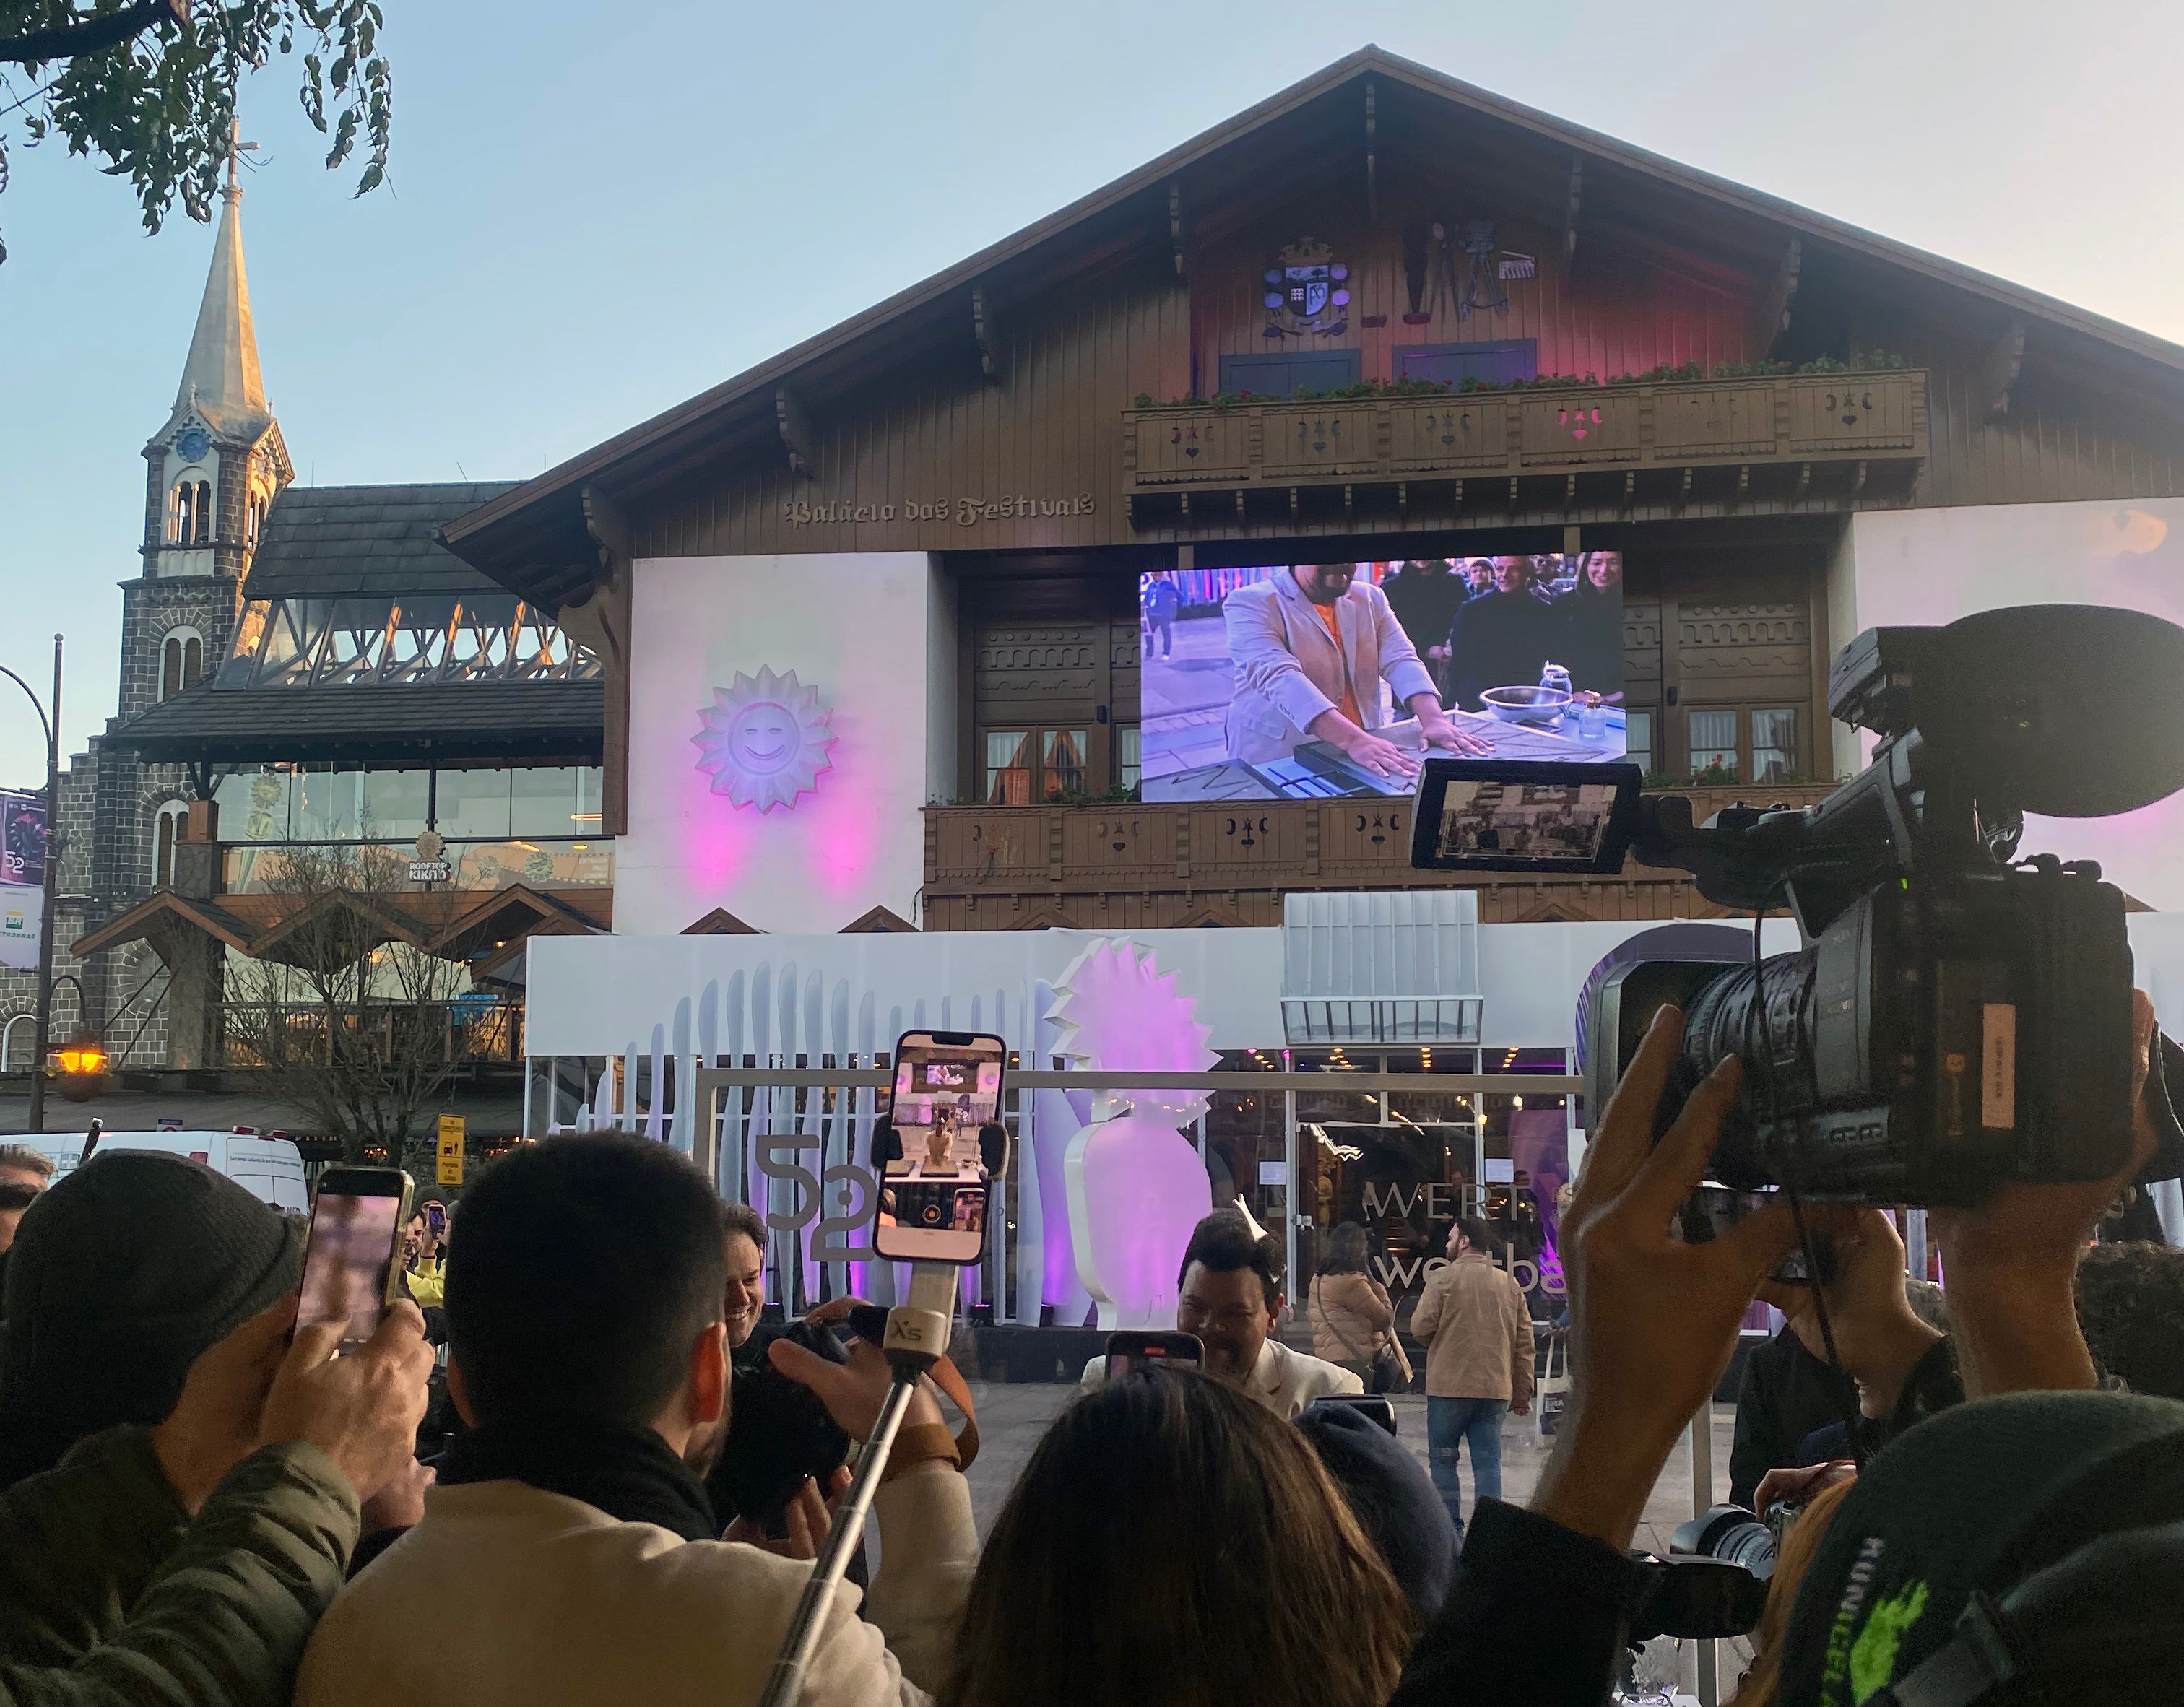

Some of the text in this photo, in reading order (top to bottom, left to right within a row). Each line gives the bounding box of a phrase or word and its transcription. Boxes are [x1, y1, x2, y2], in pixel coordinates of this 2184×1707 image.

[904, 496, 950, 522] dos
[956, 490, 1096, 527] Festivais
[5, 851, 25, 874] 52
[755, 1134, 878, 1261] 52
[1367, 1181, 1532, 1221] WERT
